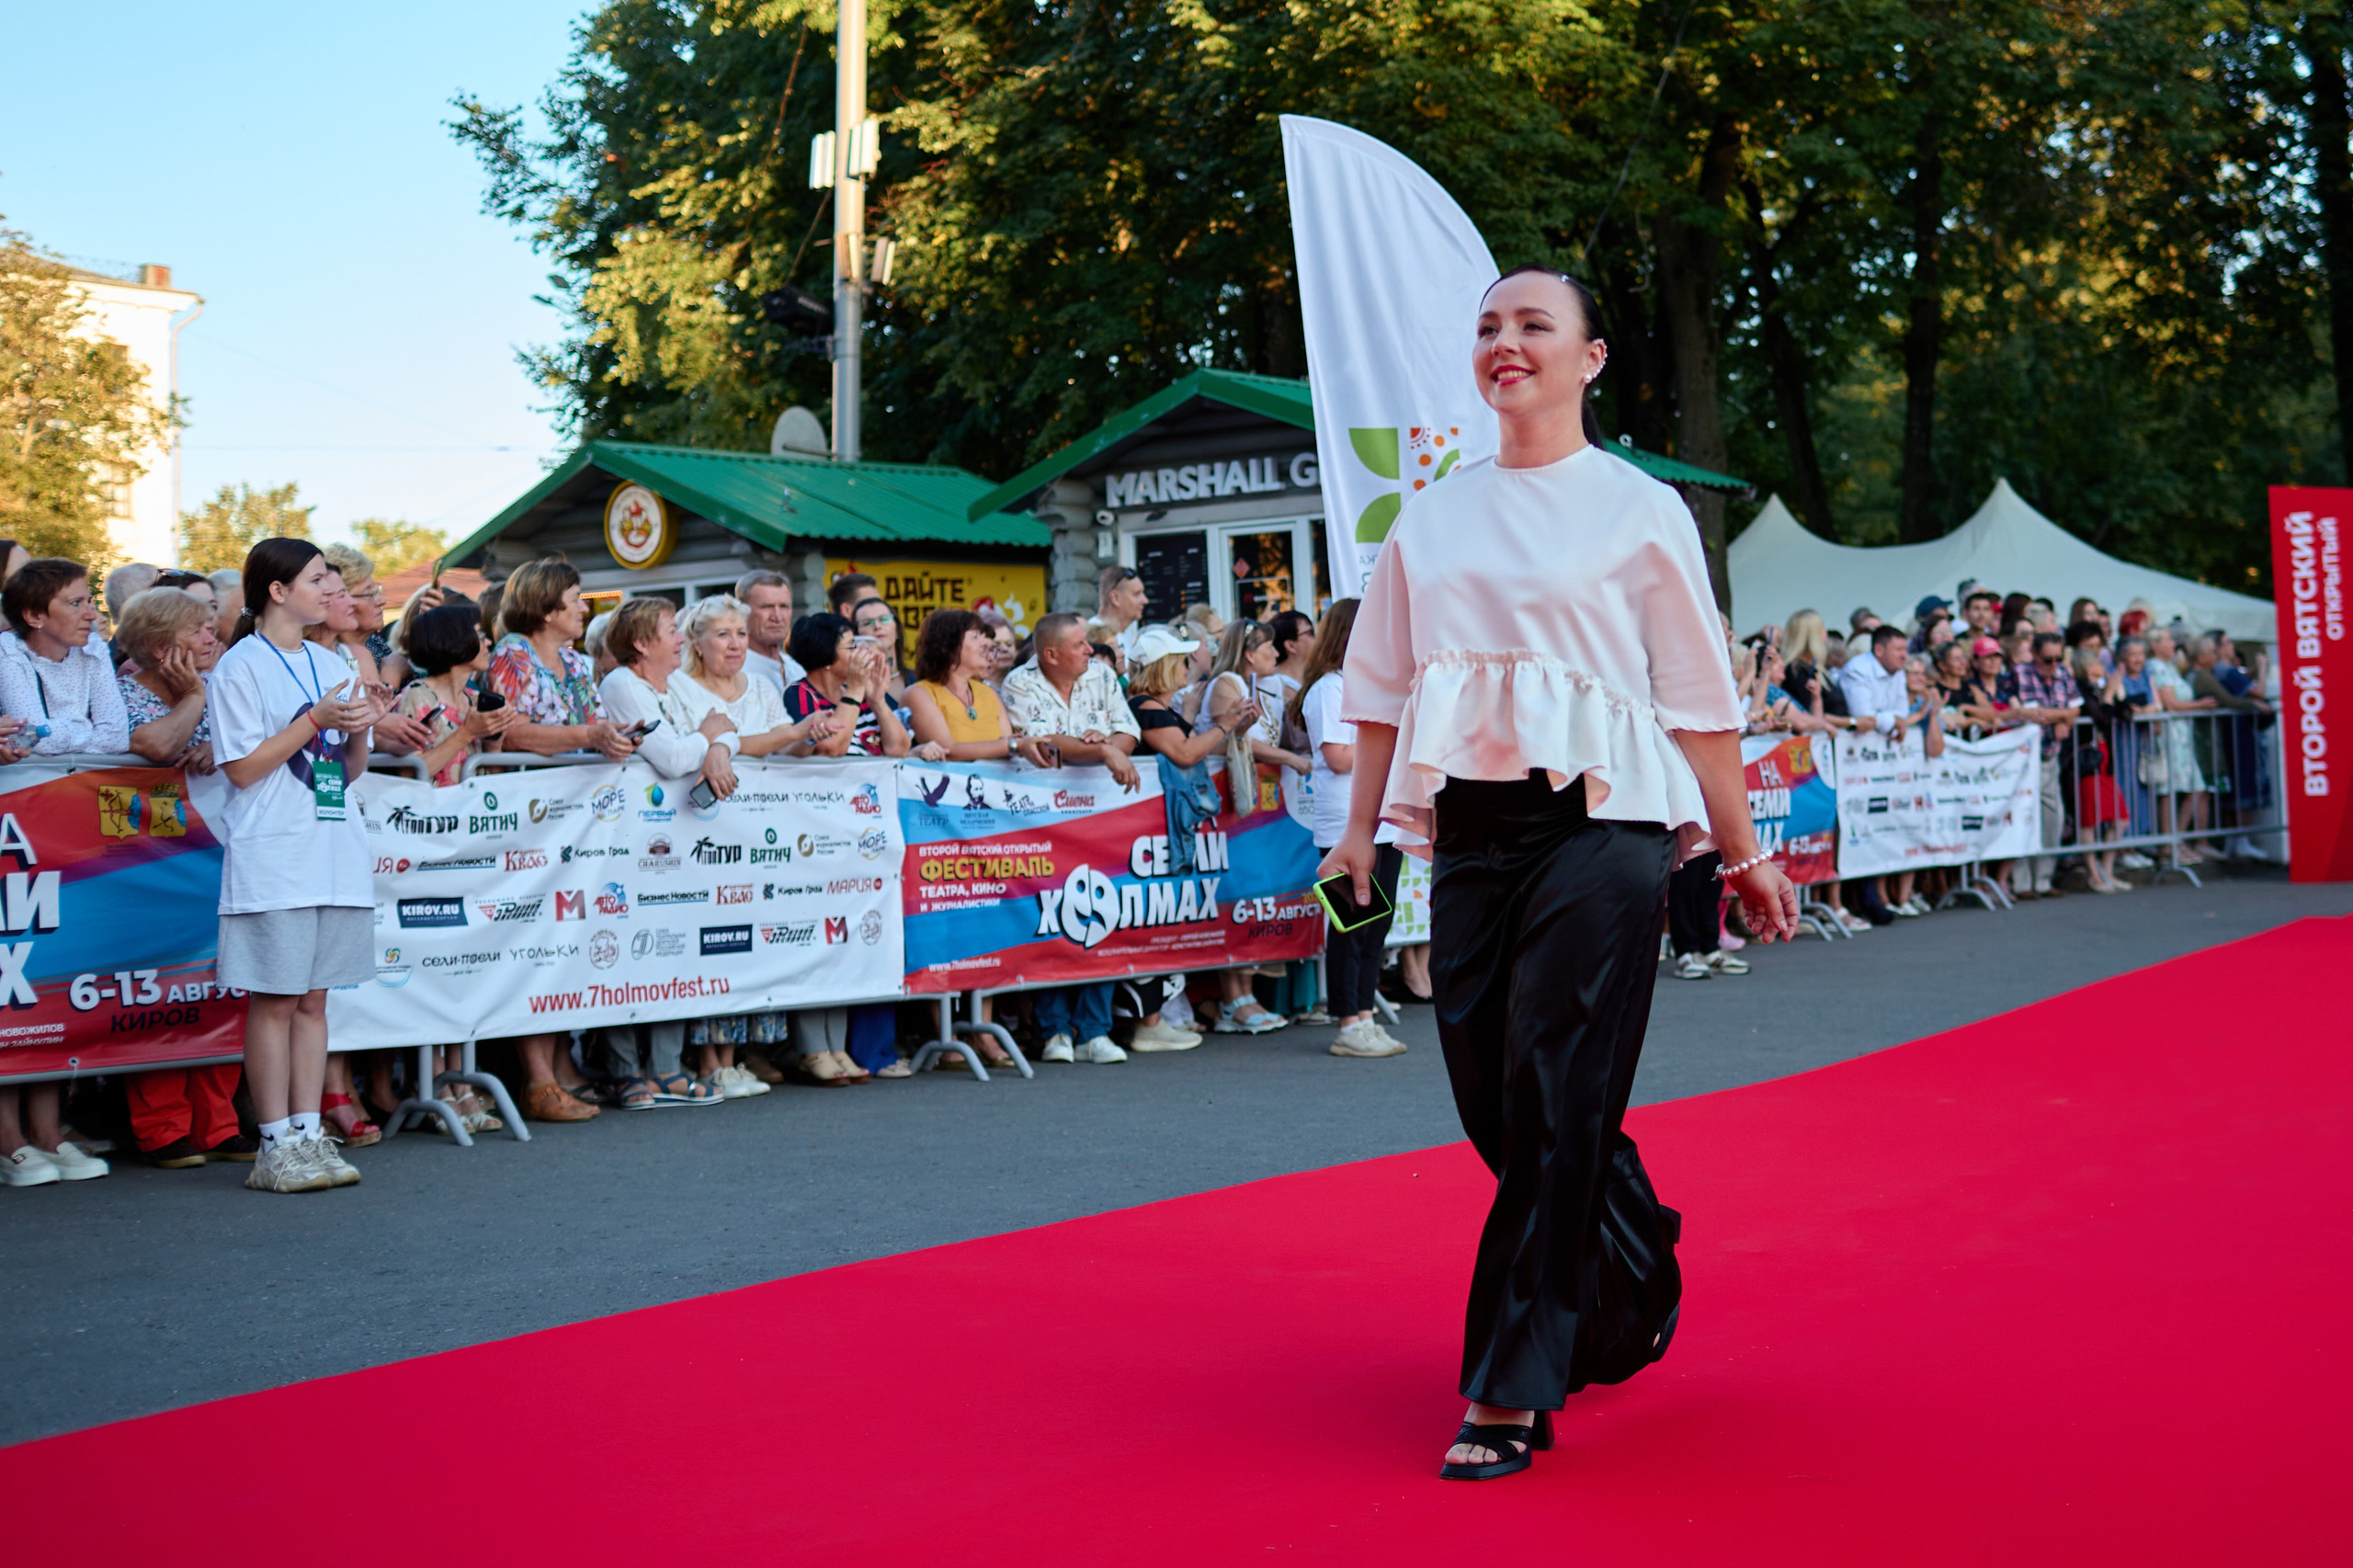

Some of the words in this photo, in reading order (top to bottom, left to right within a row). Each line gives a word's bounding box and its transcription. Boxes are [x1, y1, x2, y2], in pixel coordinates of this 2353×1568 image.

[1106, 457, 1285, 507] MARSHALL
[1290, 452, 1320, 487] G
[885, 573, 964, 602] ДАЙТЕ
[2284, 511, 2322, 659] ВЯТСКИЙ
[2317, 517, 2345, 641] ОТКРЫТЫЙ
[2294, 666, 2329, 796] ВТОРОЙ
[470, 812, 518, 835] ВЯТИЧ
[750, 846, 791, 864] ВЯТИЧ
[919, 843, 960, 857] ВТОРОЙ
[1003, 840, 1052, 855] ОТКРЫТЫЙ
[920, 856, 1055, 882] ФЕСТИВАЛЬ
[827, 878, 871, 894] МАРИЯ
[919, 885, 970, 899] ТЕАТРА,
[972, 882, 1006, 895] КИНО
[402, 903, 460, 916] KIROV.RU
[931, 898, 1001, 912] ЖУРНАЛИСТИКИ
[1233, 896, 1277, 925] 6-13
[1276, 903, 1321, 921] АВГУСТ
[703, 930, 749, 944] KIROV.RU
[1248, 922, 1293, 938] КИРОВ
[69, 970, 163, 1011] 6-13
[529, 975, 730, 1014] www.7holmovfest.ru
[0, 1022, 65, 1037] НОВОЖИЛОВ
[111, 1007, 200, 1034] КИРОВ
[10, 1035, 64, 1049] ЗАЙНУЛИН
